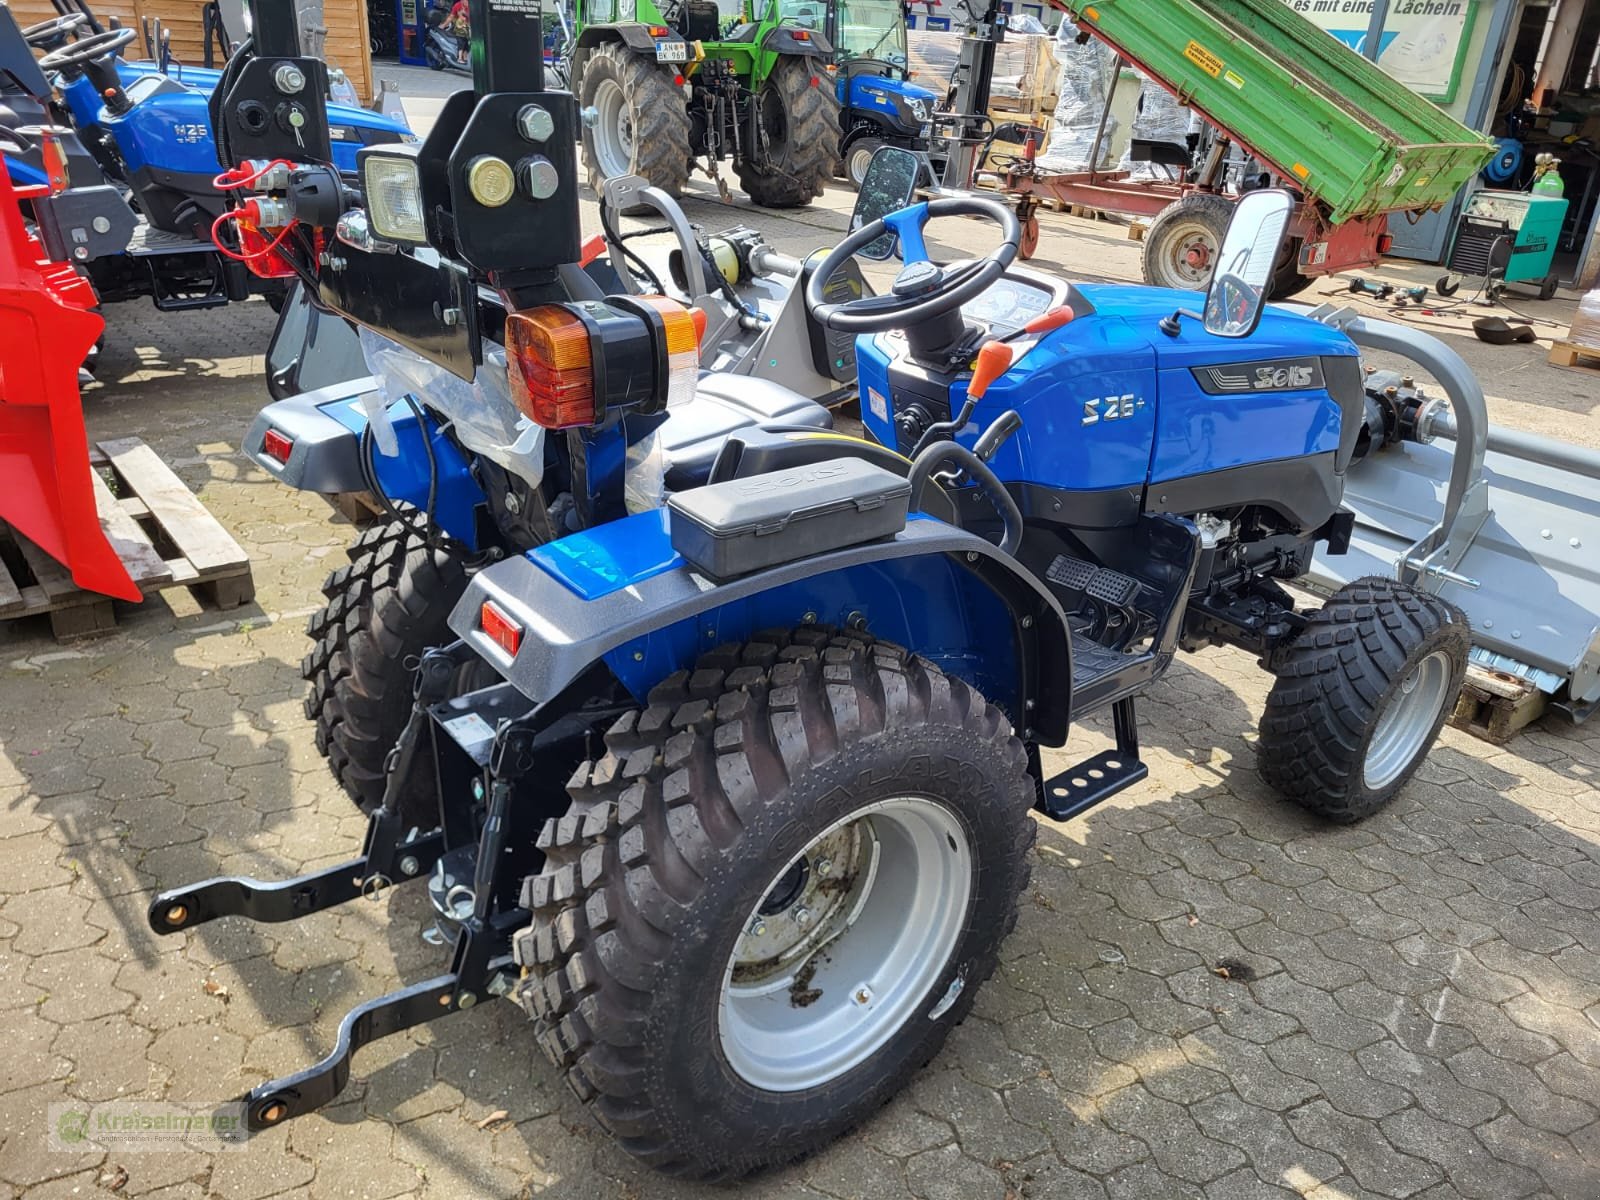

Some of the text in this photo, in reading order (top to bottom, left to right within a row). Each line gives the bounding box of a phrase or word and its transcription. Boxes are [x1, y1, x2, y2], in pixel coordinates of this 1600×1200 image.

[1294, 0, 1461, 16] es mit eine Lächeln
